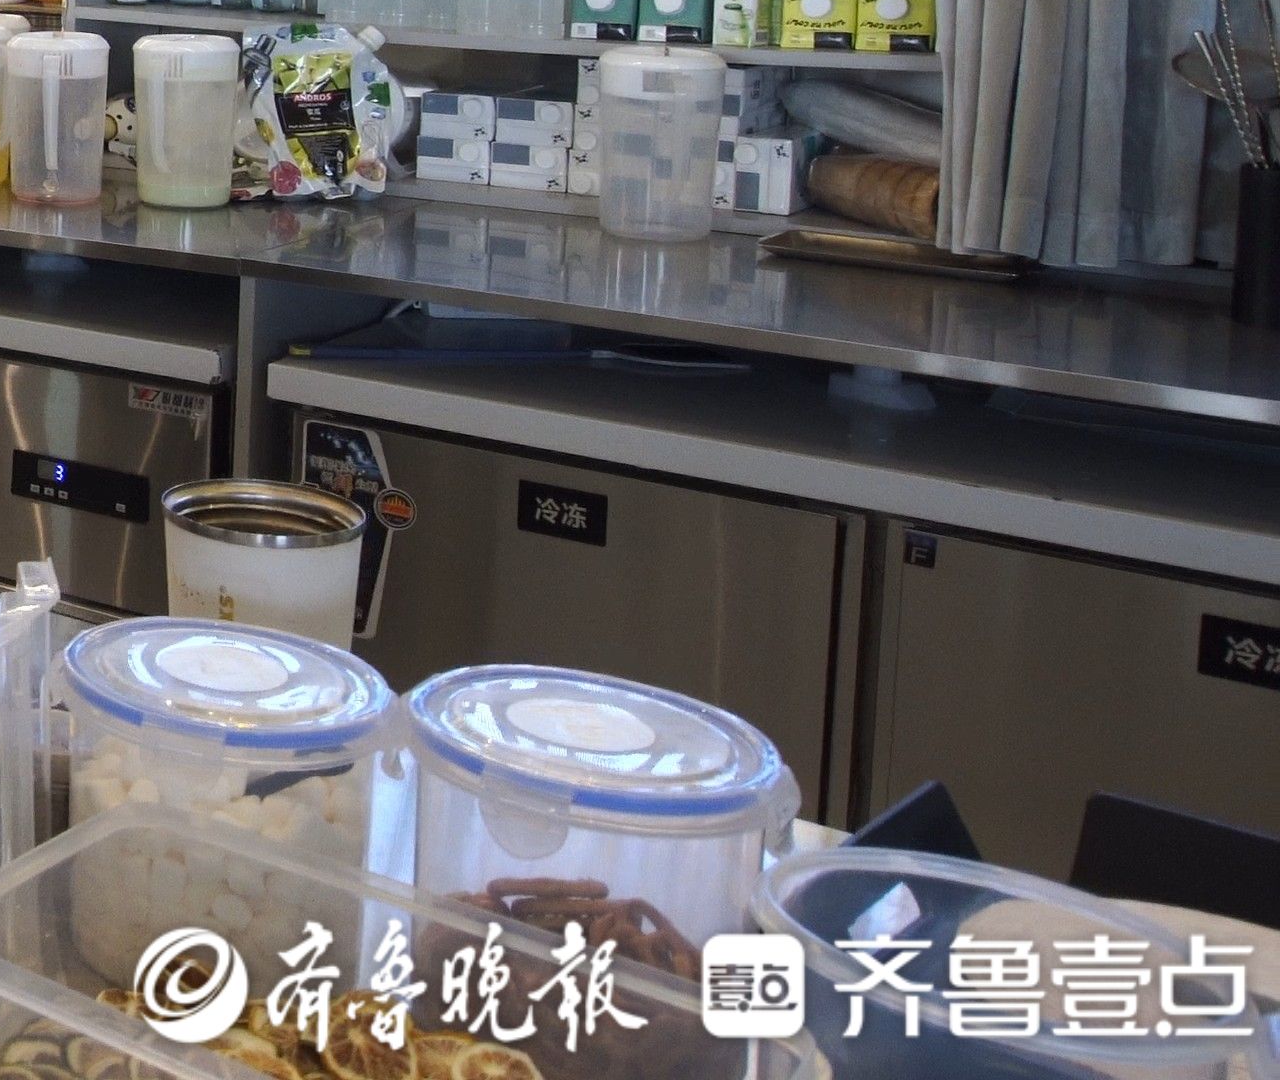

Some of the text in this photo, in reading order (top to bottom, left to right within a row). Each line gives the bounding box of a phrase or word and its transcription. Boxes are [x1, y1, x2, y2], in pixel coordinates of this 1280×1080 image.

[294, 93, 332, 102] ANDROS
[54, 464, 65, 482] 3
[534, 496, 589, 530] 冷冻
[909, 546, 928, 566] F
